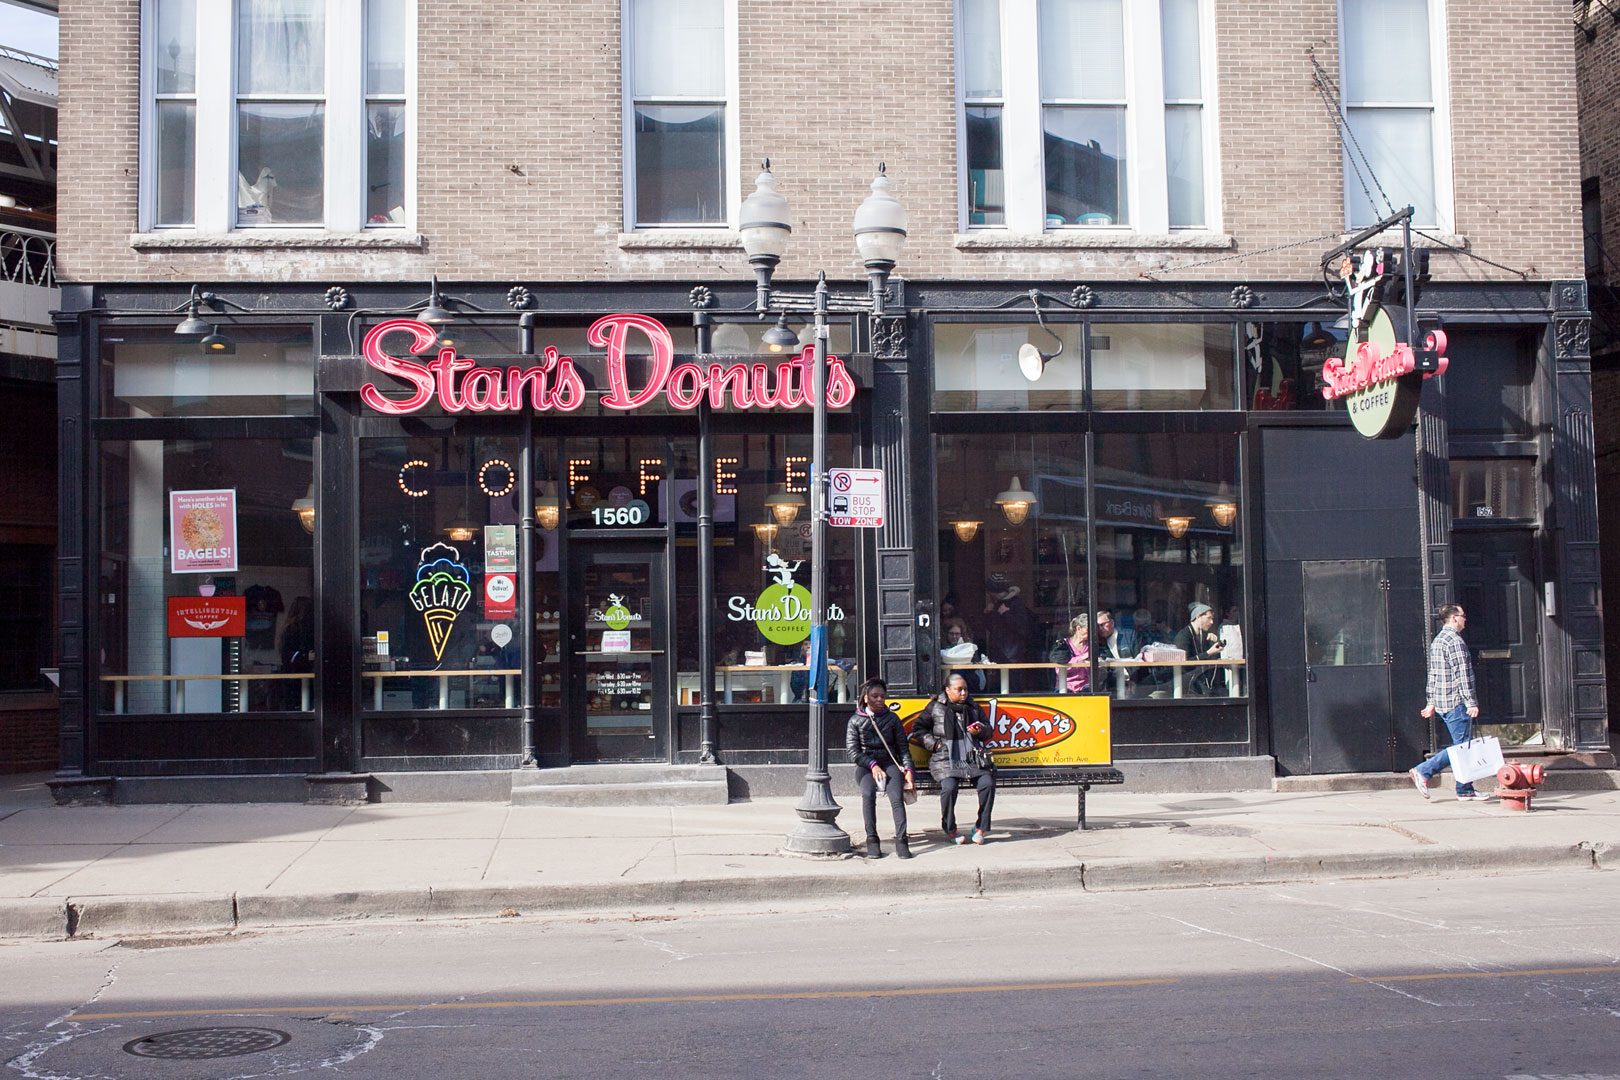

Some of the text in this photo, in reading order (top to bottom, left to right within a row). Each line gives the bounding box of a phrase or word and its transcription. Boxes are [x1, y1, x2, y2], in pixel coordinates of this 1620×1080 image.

[360, 313, 856, 414] Stan's Donuts
[1360, 392, 1389, 411] COFFEE
[852, 496, 871, 505] BUS
[591, 507, 642, 525] 1560
[852, 506, 875, 515] STOP
[833, 517, 878, 526] TOW ZONE
[177, 547, 231, 560] BAGELS!
[409, 585, 471, 612] GELATO
[727, 596, 781, 622] Stan's
[1020, 756, 1039, 764] 2057
